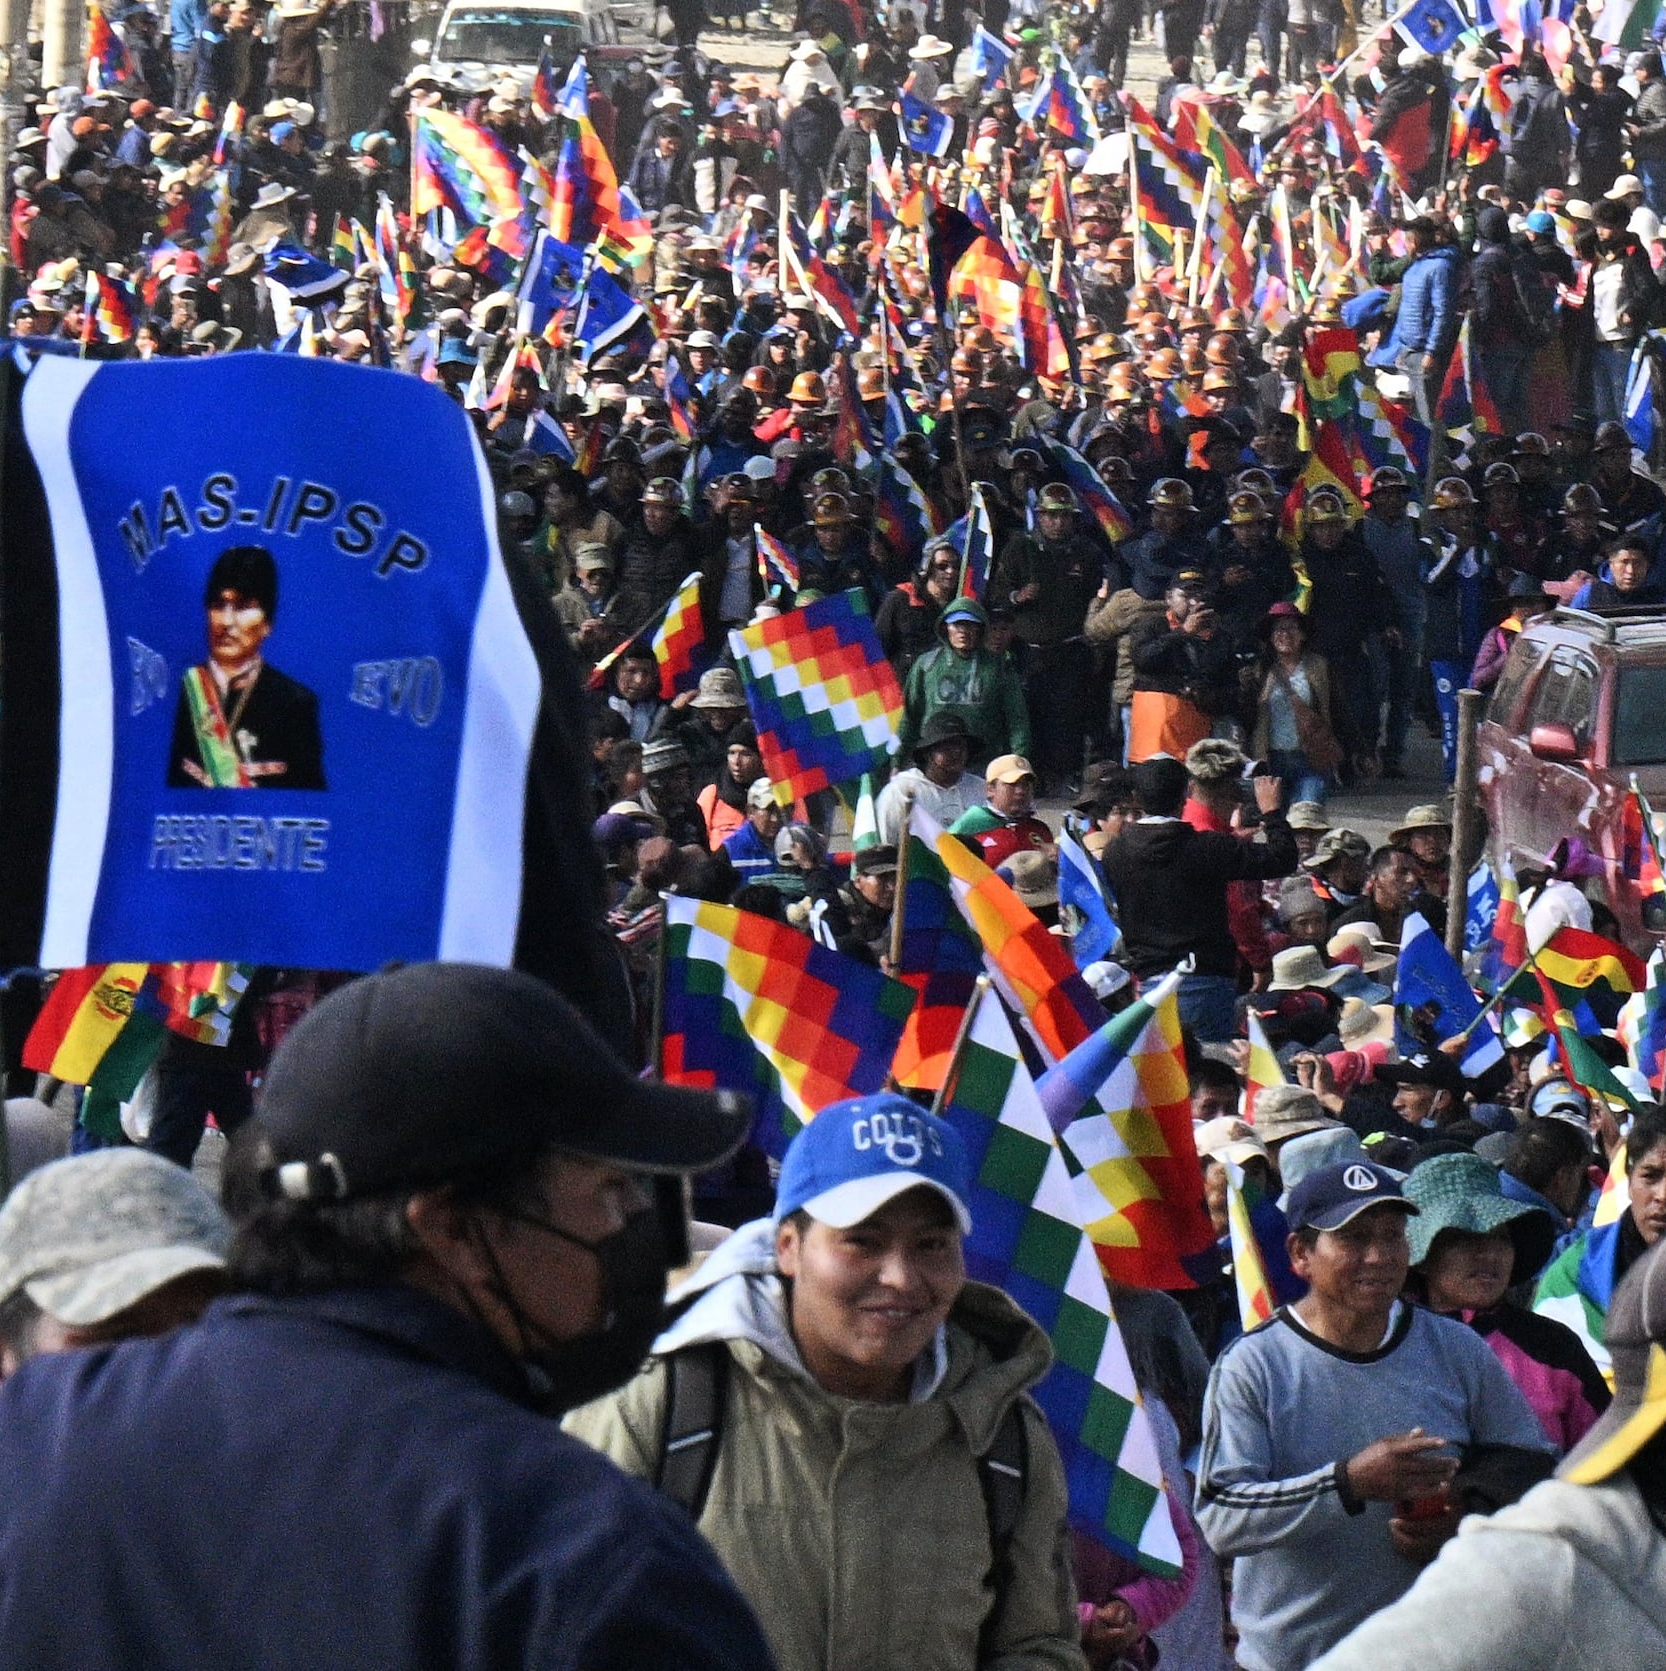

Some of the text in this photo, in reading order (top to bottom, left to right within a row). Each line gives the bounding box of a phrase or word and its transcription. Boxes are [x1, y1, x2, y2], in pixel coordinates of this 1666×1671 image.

[118, 472, 430, 581] MAS-IPSP
[350, 655, 443, 727] EVO
[853, 1113, 943, 1157] COLTS
